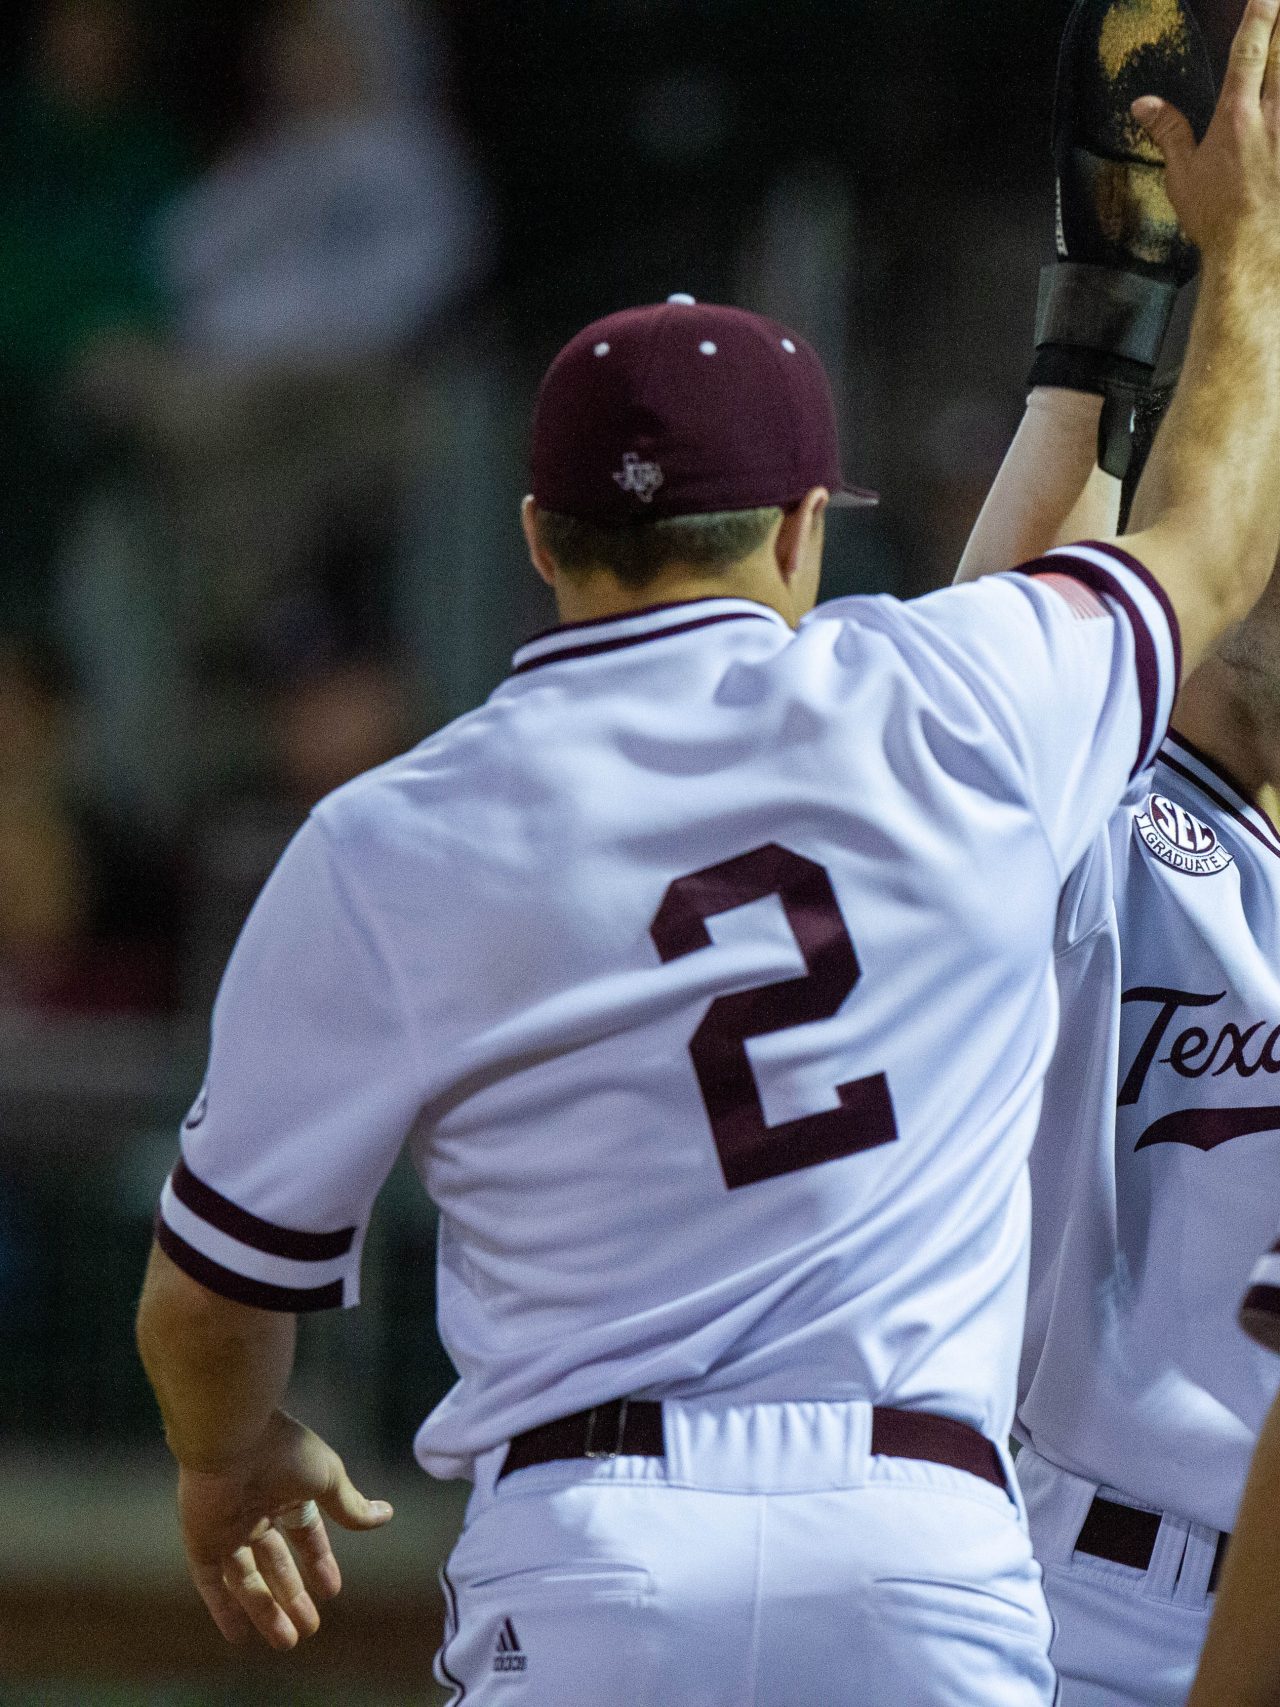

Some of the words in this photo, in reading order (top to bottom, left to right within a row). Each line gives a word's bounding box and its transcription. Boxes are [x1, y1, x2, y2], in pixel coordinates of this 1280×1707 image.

[1152, 795, 1214, 852] SEC
[1145, 832, 1222, 873] GRADUATE
[650, 841, 899, 1190] 2
